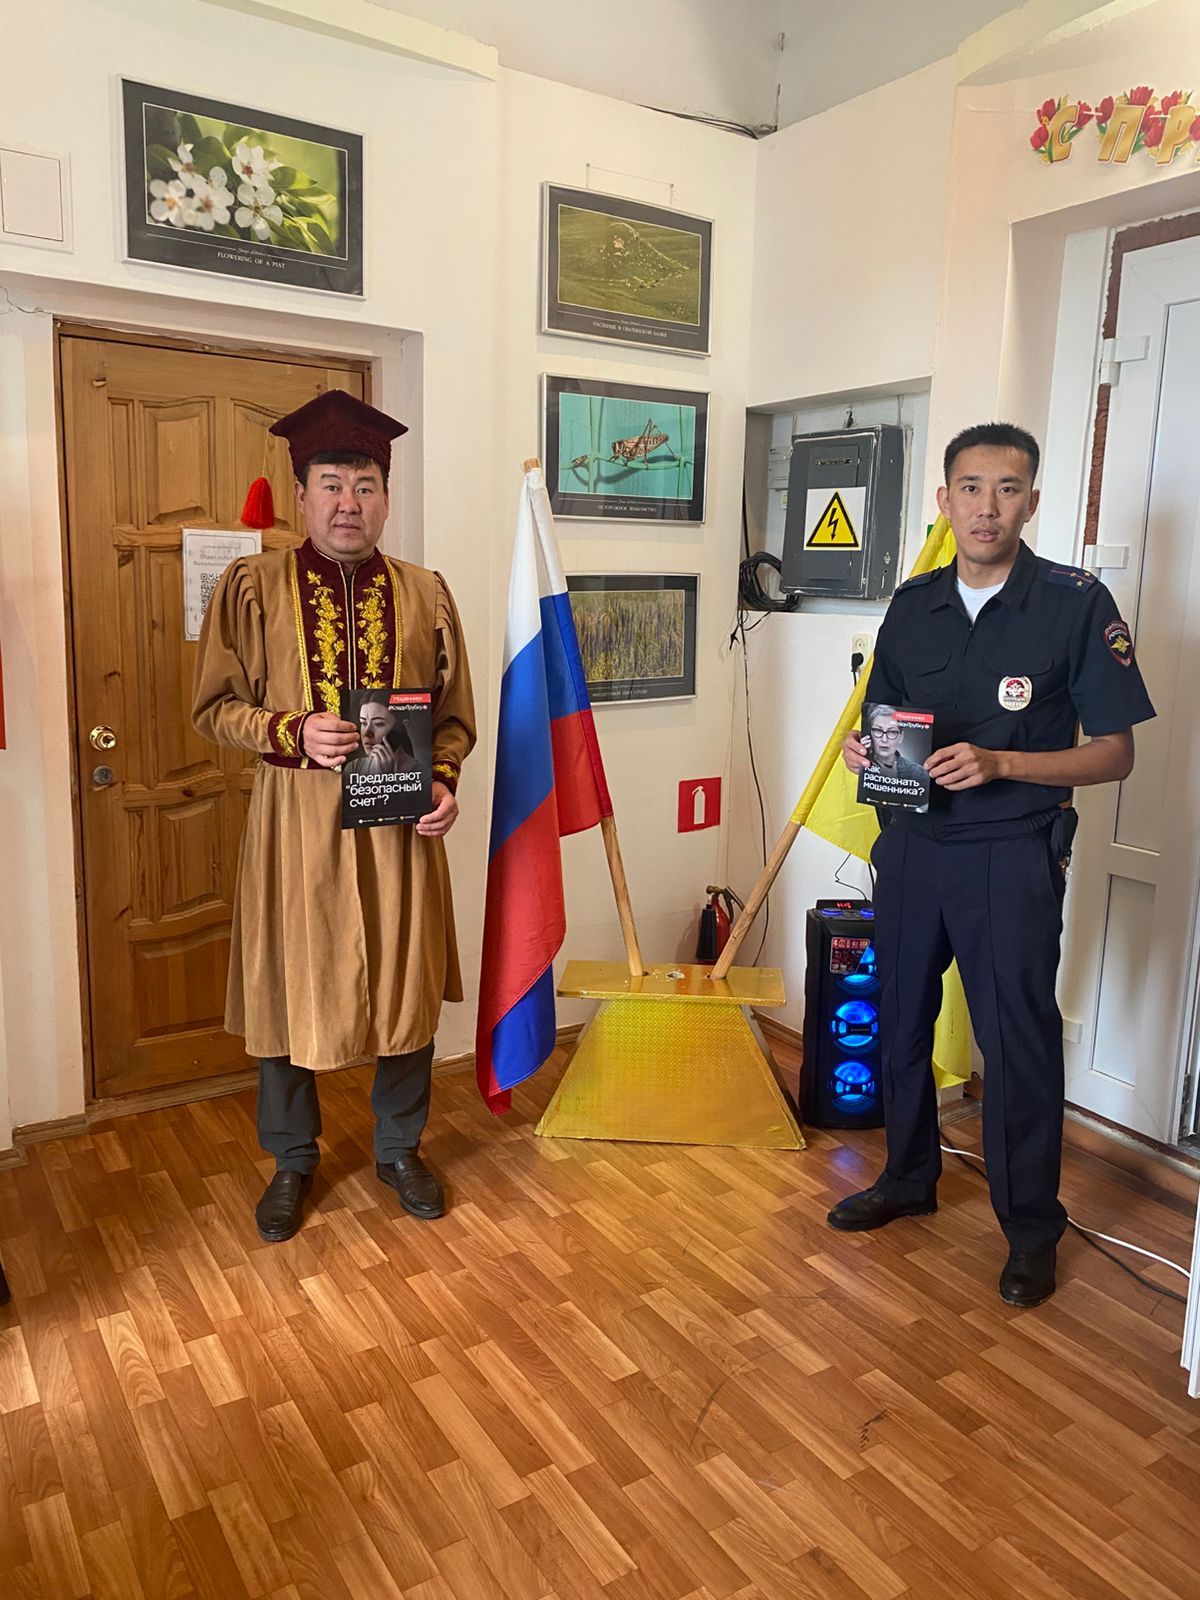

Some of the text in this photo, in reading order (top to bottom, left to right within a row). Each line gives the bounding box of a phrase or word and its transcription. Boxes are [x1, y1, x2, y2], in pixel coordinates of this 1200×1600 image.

[217, 252, 253, 263] FLOWERING
[349, 771, 422, 786] Предлагают
[863, 773, 920, 787] распознать
[863, 782, 925, 796] мошенника?
